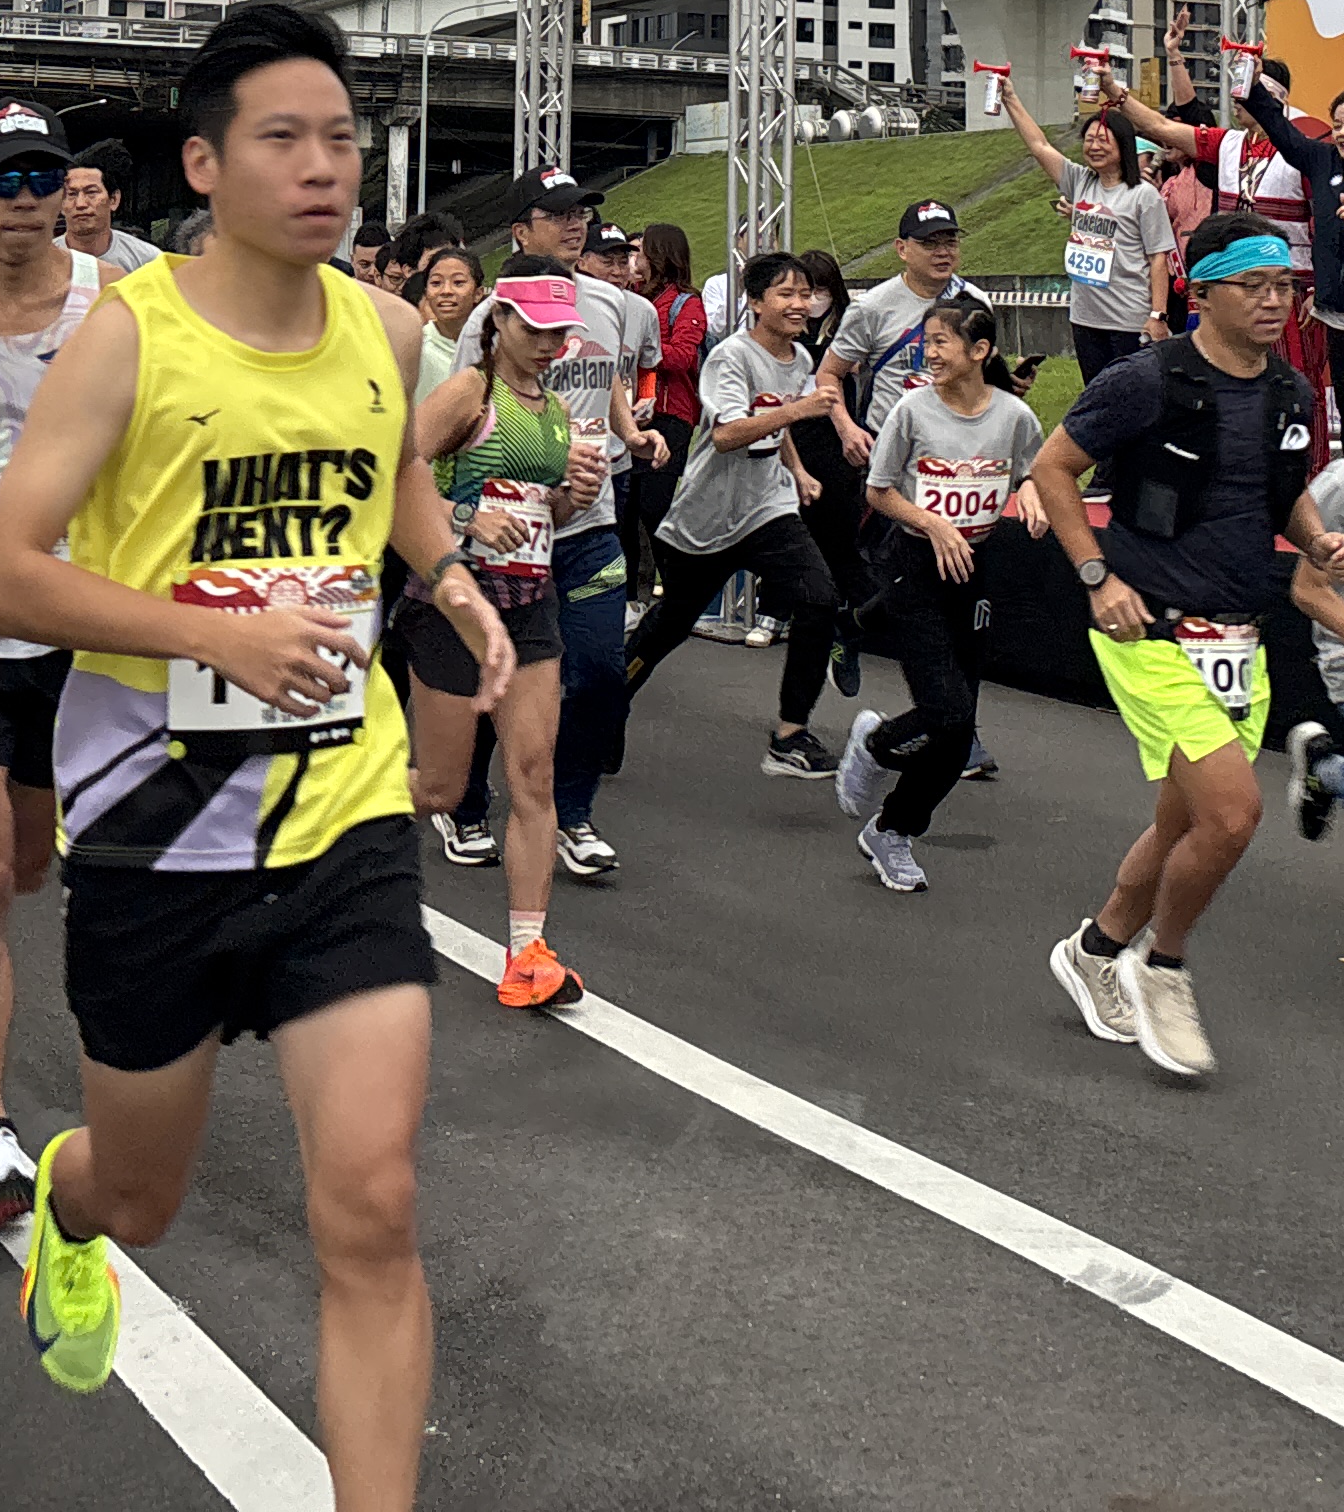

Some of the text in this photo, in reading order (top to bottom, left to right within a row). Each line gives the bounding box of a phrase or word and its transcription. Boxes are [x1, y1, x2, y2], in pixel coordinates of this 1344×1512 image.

[1068, 251, 1106, 274] 4250
[202, 447, 378, 512] WHAT'S
[924, 488, 999, 517] 2004
[189, 503, 352, 564] NEXT?
